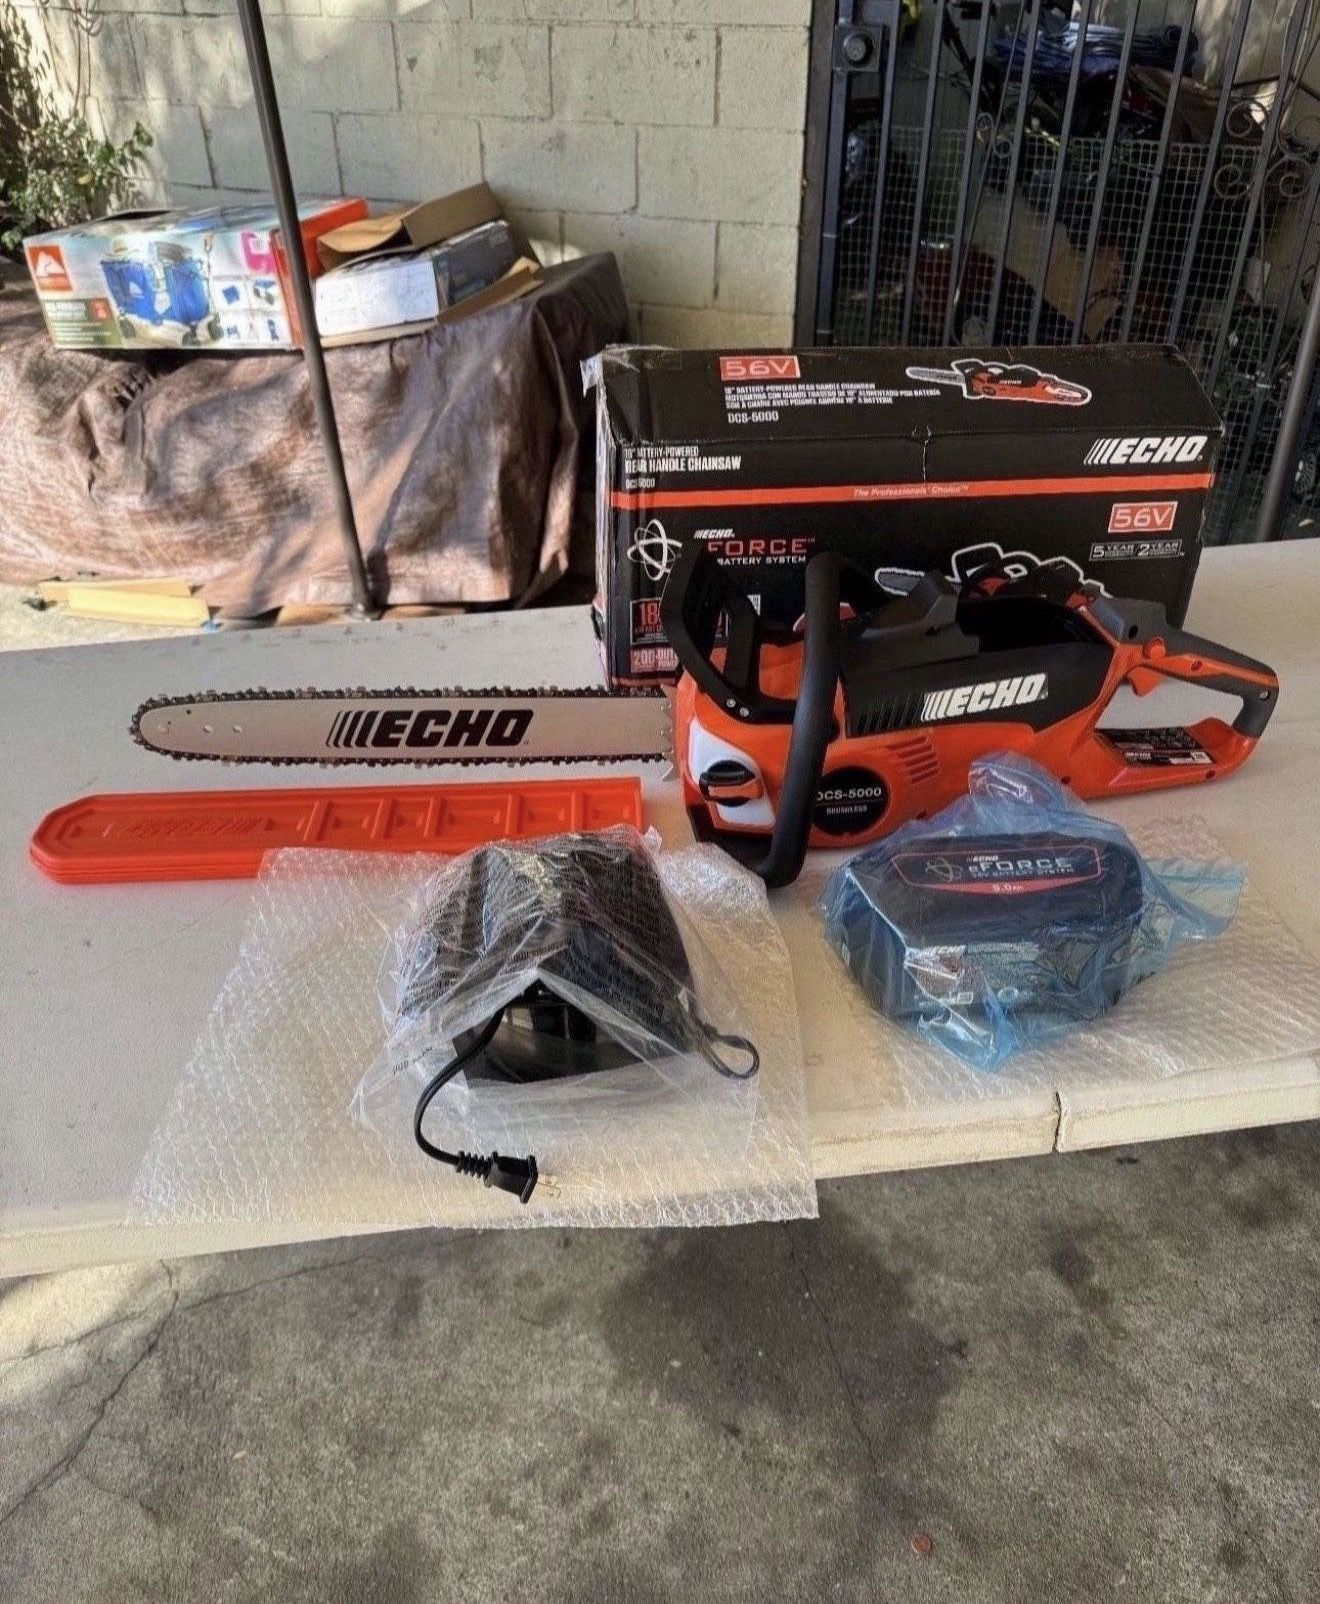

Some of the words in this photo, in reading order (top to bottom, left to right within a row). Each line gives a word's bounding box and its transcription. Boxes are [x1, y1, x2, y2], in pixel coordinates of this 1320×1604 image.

[725, 359, 792, 377] 56V
[1109, 435, 1208, 464] ECHO
[649, 458, 687, 472] HANDLE
[687, 455, 741, 471] CHAINSAW
[1113, 506, 1172, 529] 56V
[701, 528, 734, 539] ECHO
[716, 556, 762, 566] BATTERY
[765, 555, 806, 565] SYSTEM
[639, 602, 658, 625] 18
[945, 673, 1046, 717] ECHO
[371, 709, 534, 747] ECHO
